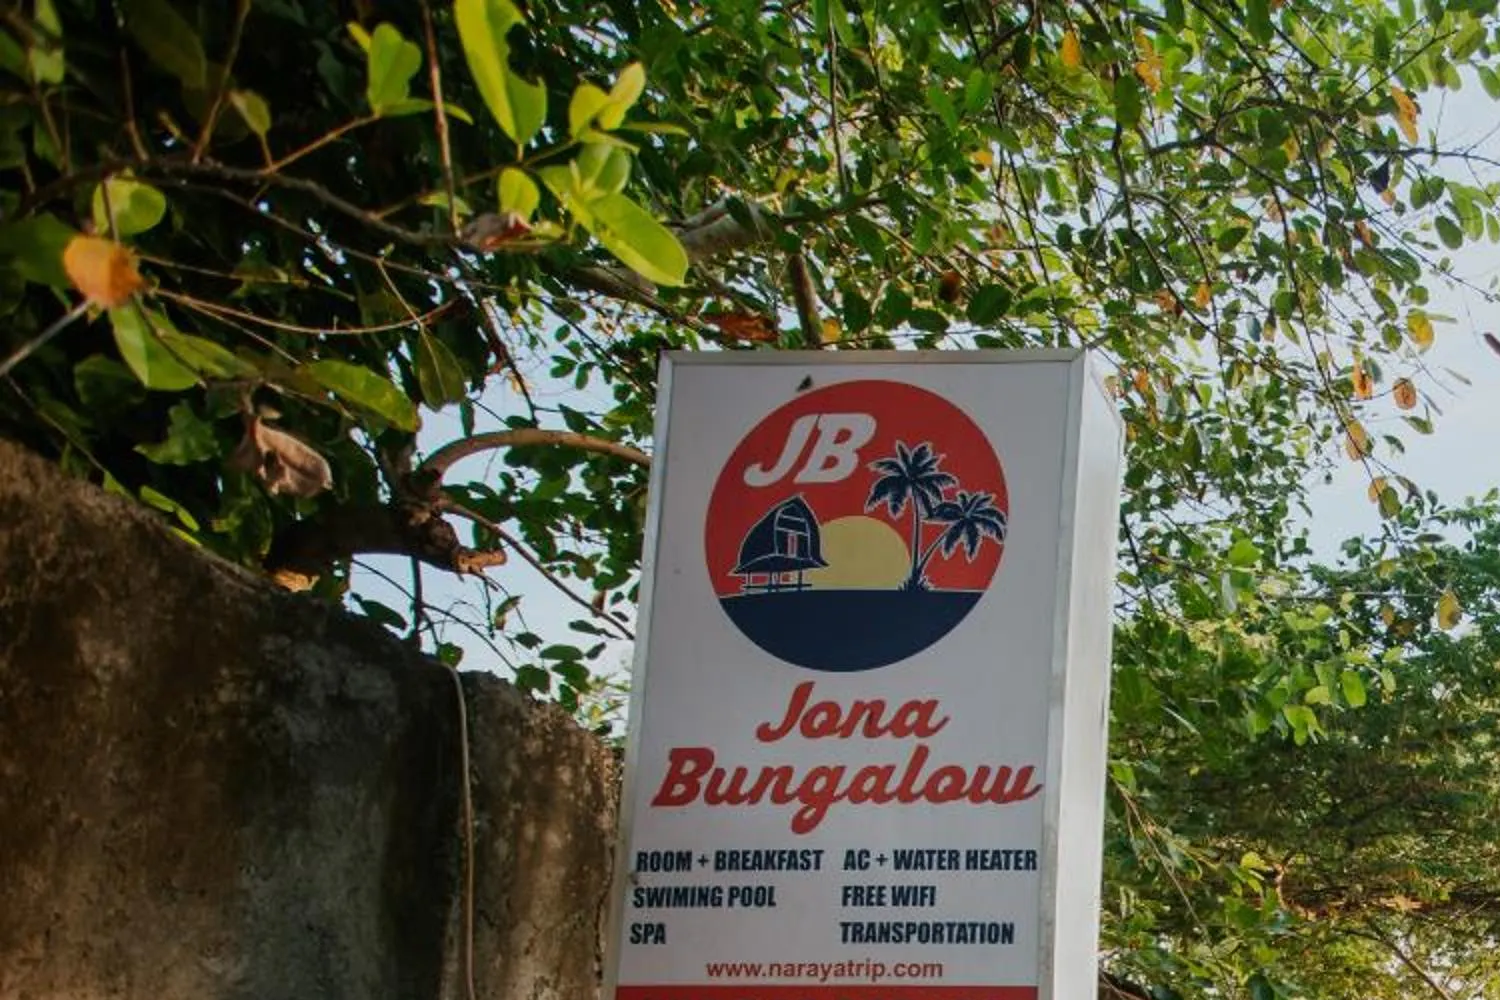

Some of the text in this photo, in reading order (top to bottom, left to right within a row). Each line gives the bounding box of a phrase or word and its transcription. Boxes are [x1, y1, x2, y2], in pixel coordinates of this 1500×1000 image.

[743, 412, 877, 487] JB
[755, 681, 950, 742] Jona
[650, 744, 1043, 835] Bungalow
[636, 851, 693, 872] ROOM
[714, 850, 824, 871] BREAKFAST
[843, 849, 870, 871] AC
[893, 849, 960, 871] WATER
[964, 849, 1038, 871] HEATER
[633, 886, 776, 908] SWIMING POOL
[841, 885, 936, 907] FREE WIFI
[630, 923, 667, 944] SPA
[840, 922, 1015, 945] TRANSPORTATION
[706, 958, 943, 981] www.narayatrip.com
